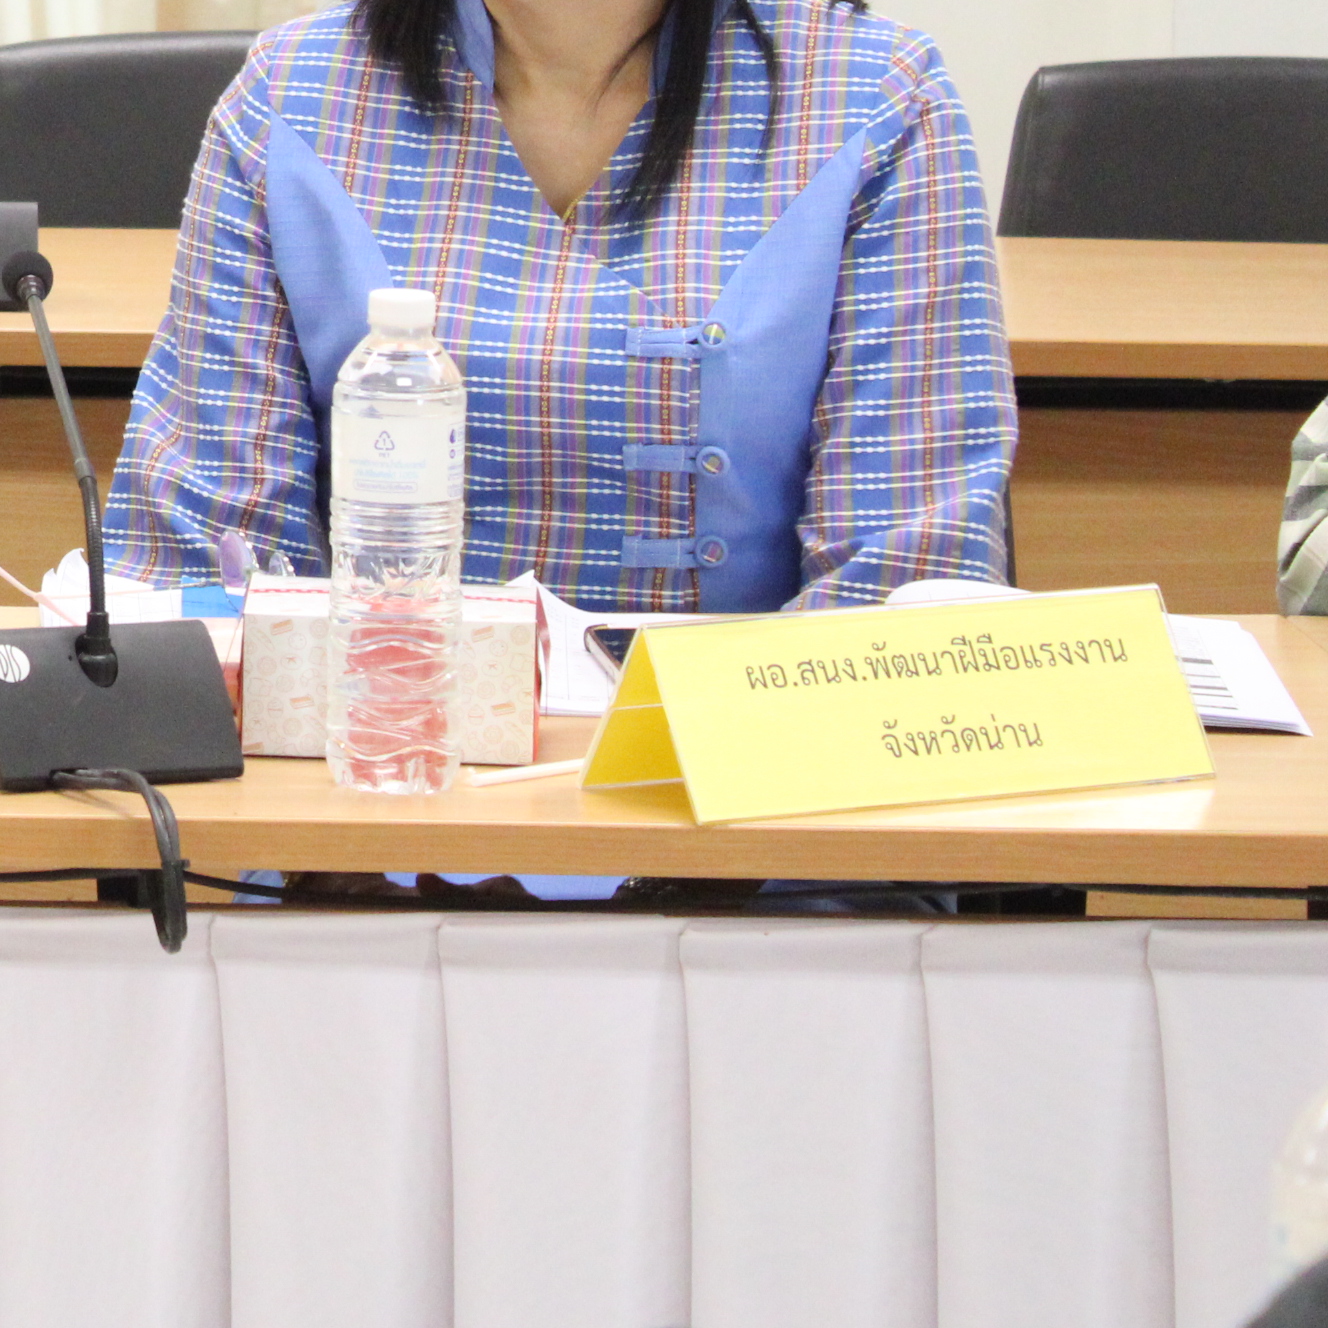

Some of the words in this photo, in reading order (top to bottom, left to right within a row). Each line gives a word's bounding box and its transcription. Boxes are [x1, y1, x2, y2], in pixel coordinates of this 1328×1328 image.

[745, 633, 1128, 691] ผอ.สนง.พัฒนาฝีมือแรงงาน
[880, 714, 1043, 759] จังหวัดน่าน
